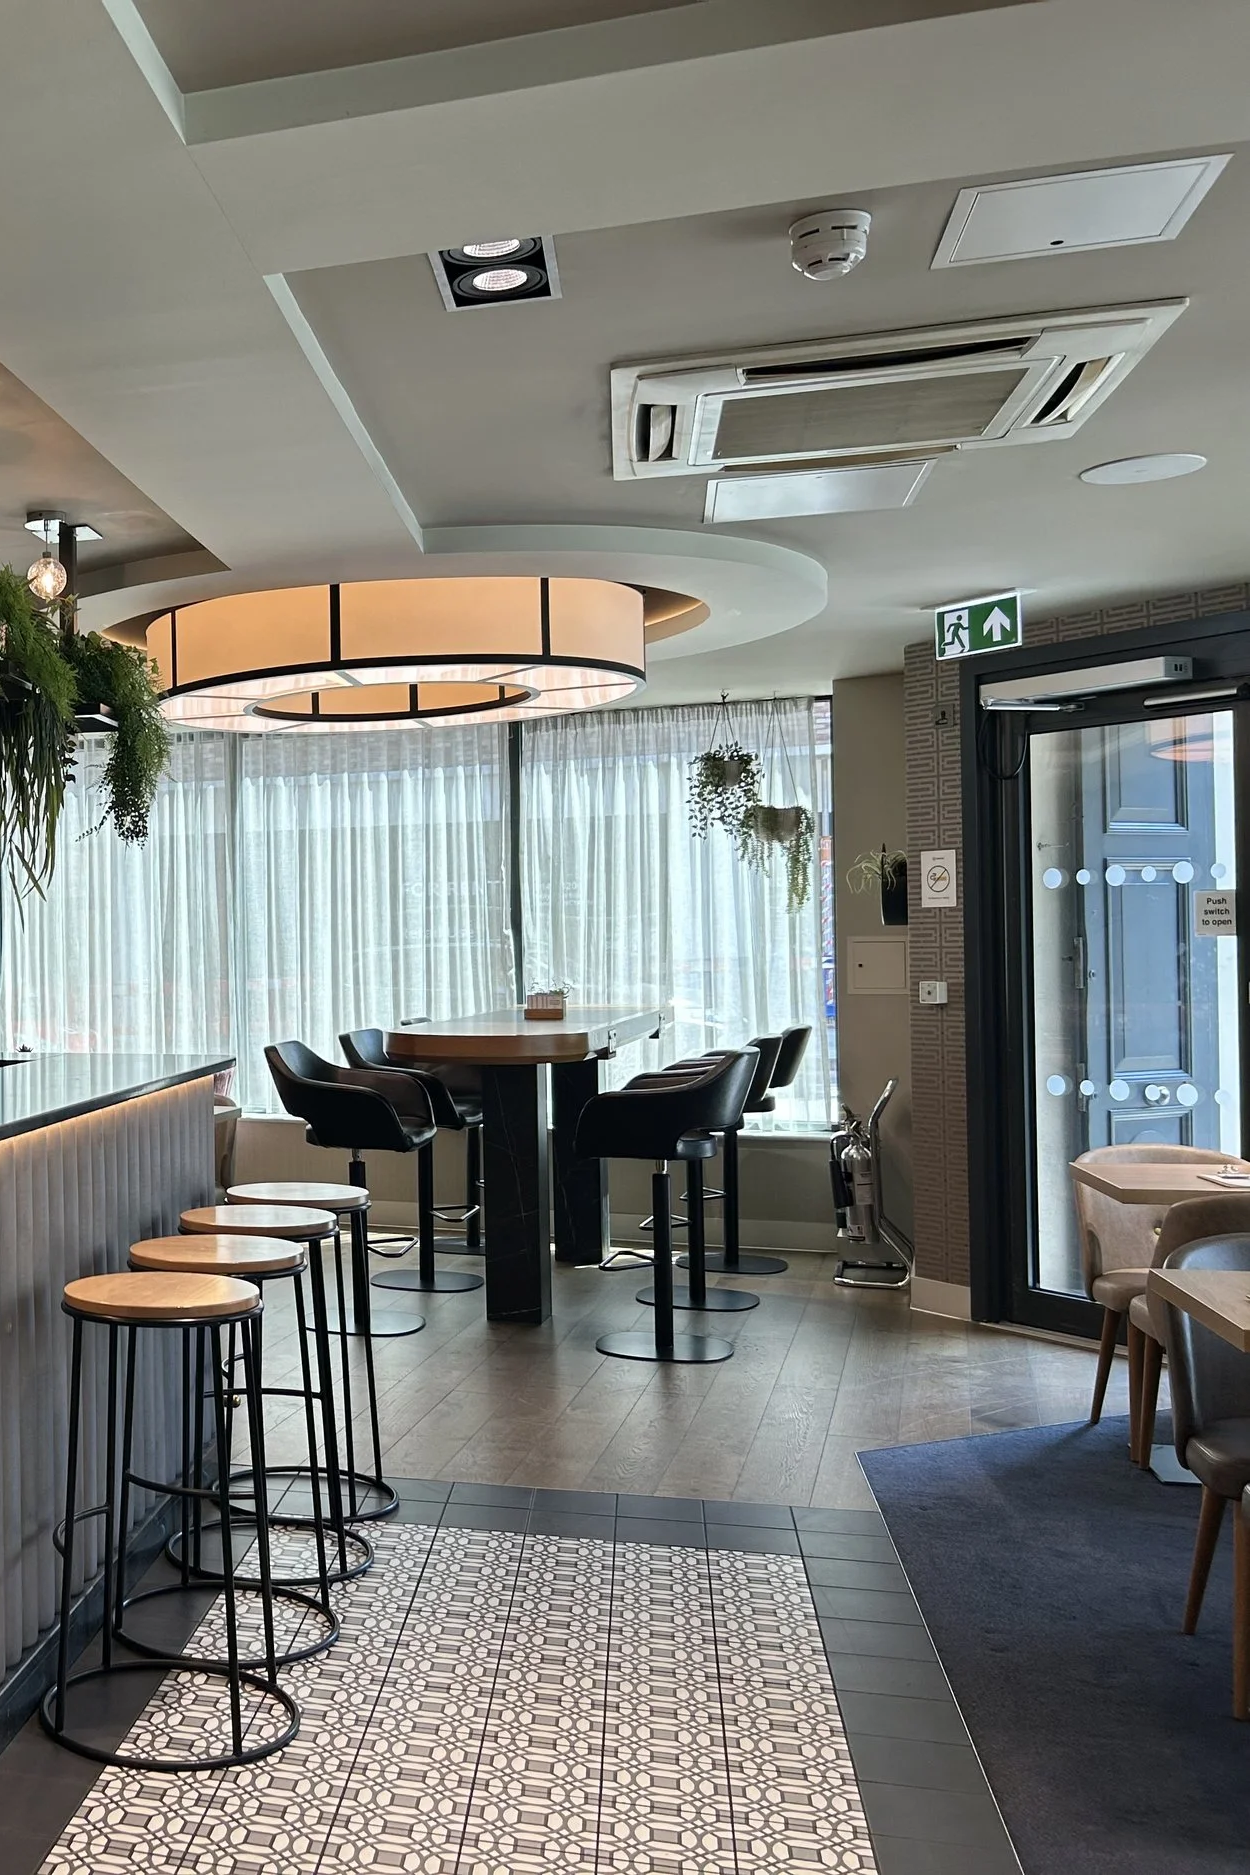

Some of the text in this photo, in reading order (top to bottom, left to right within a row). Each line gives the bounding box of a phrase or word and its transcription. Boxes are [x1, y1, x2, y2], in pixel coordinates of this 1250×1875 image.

[1206, 897, 1227, 905] Push
[1203, 908, 1230, 916] switch
[1202, 918, 1232, 927] to open
